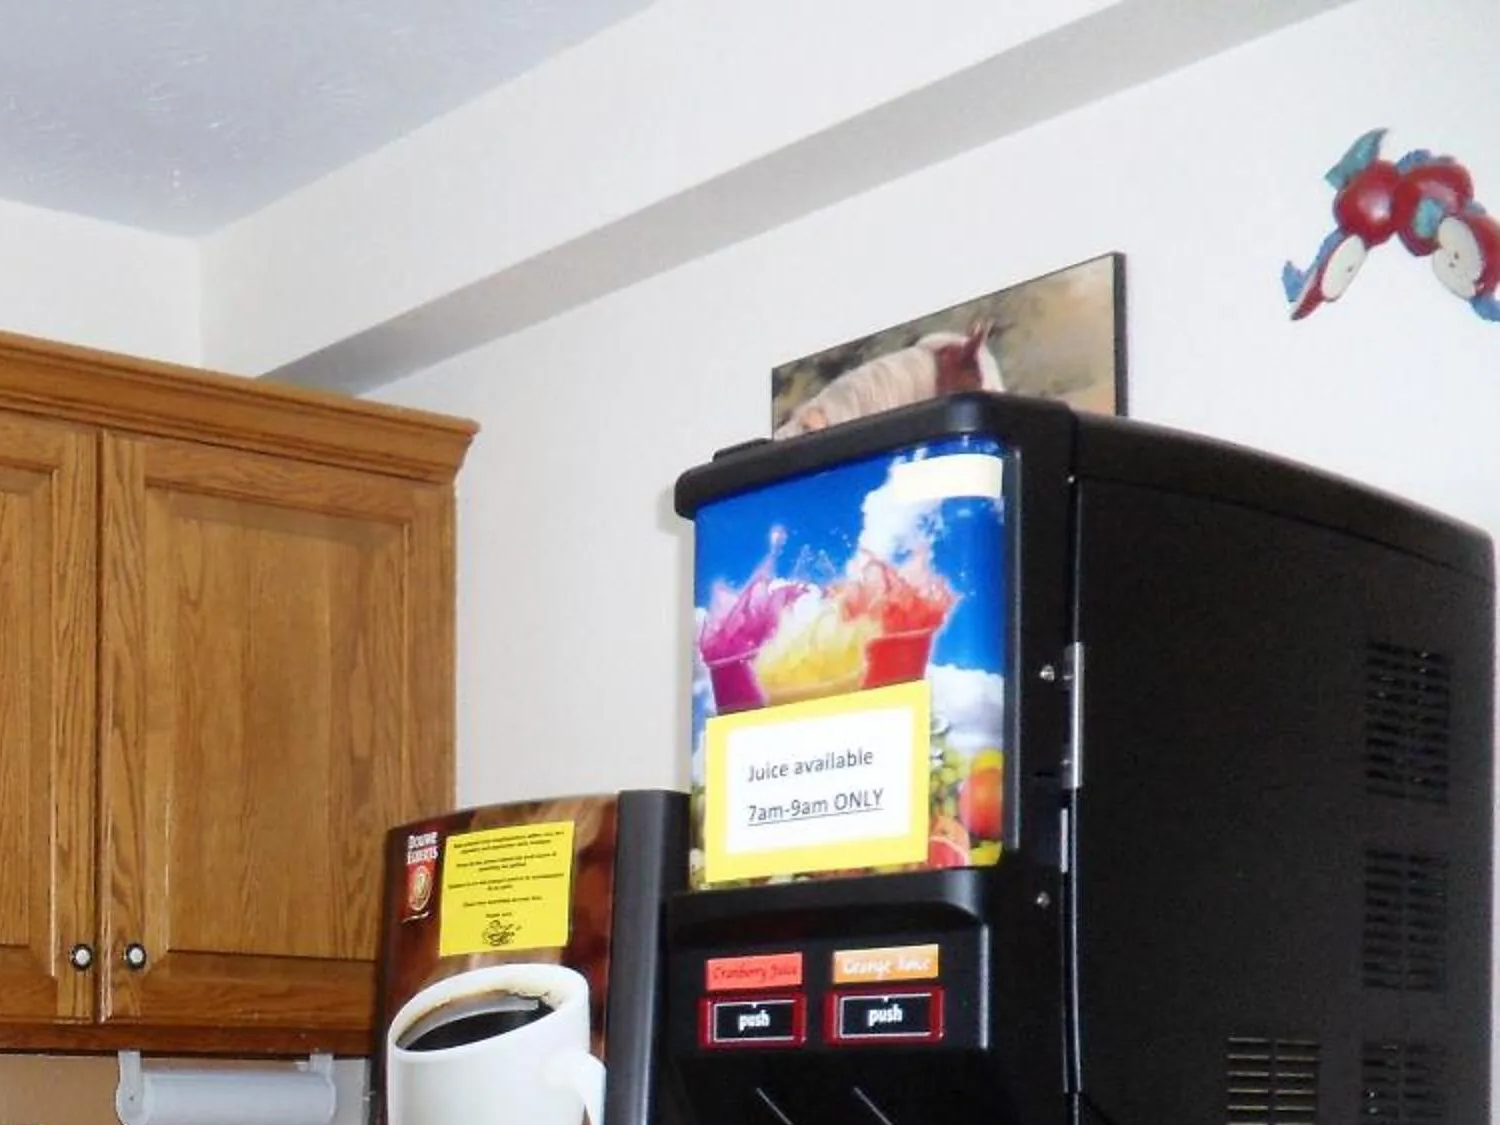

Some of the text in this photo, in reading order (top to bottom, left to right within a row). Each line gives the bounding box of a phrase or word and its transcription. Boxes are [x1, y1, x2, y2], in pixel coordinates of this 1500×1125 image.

[748, 748, 874, 782] Juice available
[748, 788, 884, 822] 7am-9am ONLY
[738, 1010, 771, 1031] push
[867, 1004, 903, 1027] push
